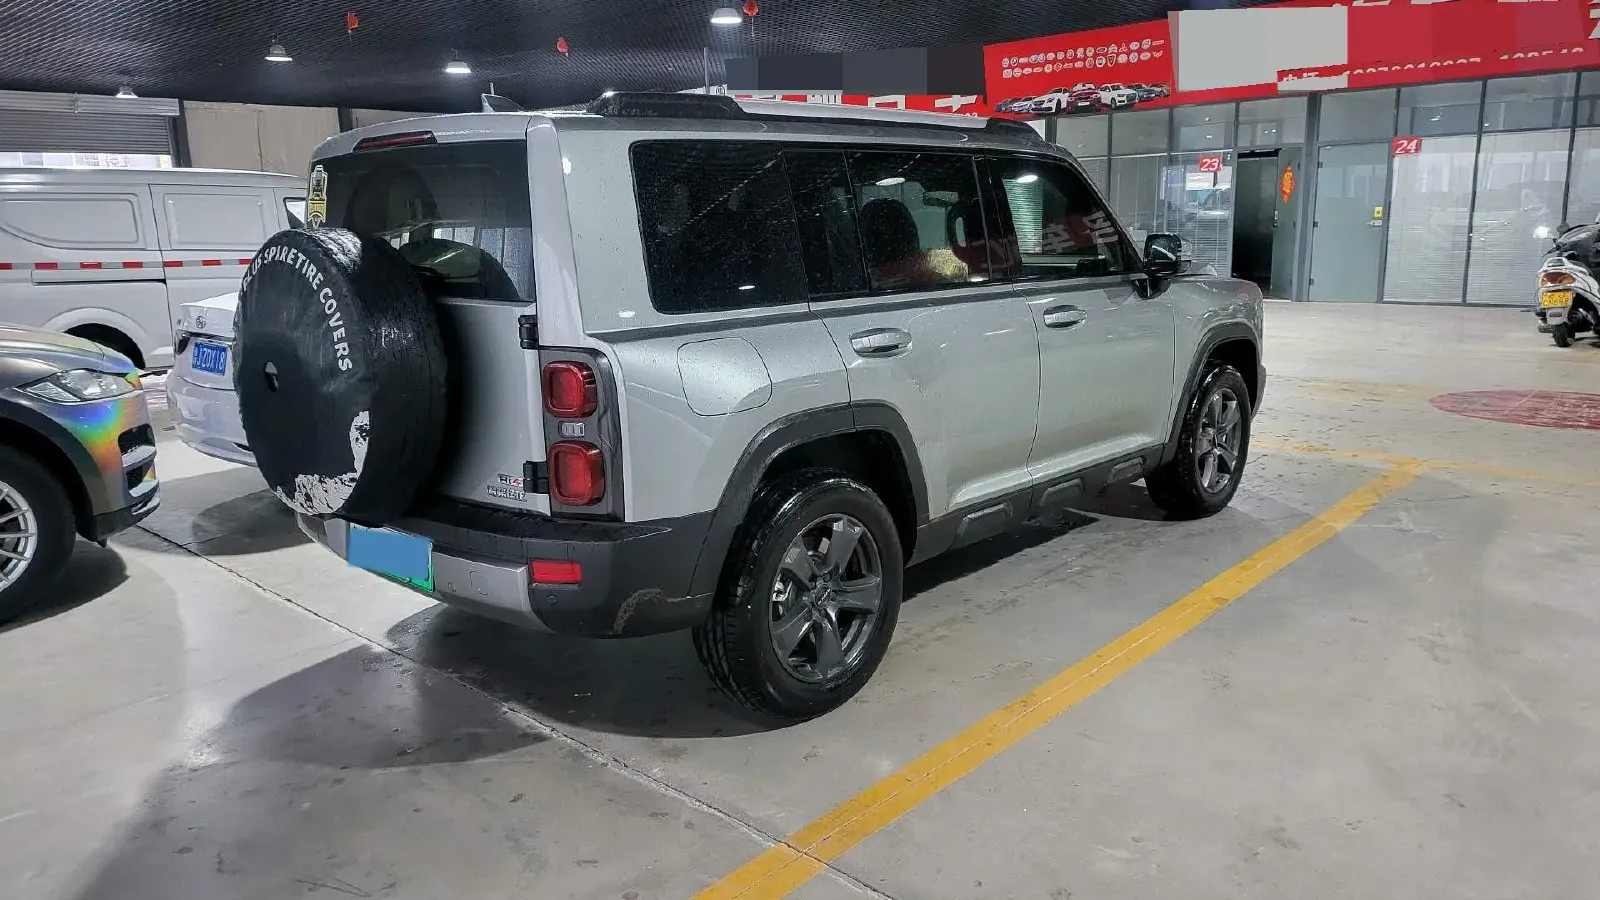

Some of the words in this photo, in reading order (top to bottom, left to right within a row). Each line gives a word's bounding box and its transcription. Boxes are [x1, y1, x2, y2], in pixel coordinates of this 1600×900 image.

[1395, 139, 1418, 154] 24
[1200, 158, 1220, 172] 23
[319, 287, 353, 371] COVERS
